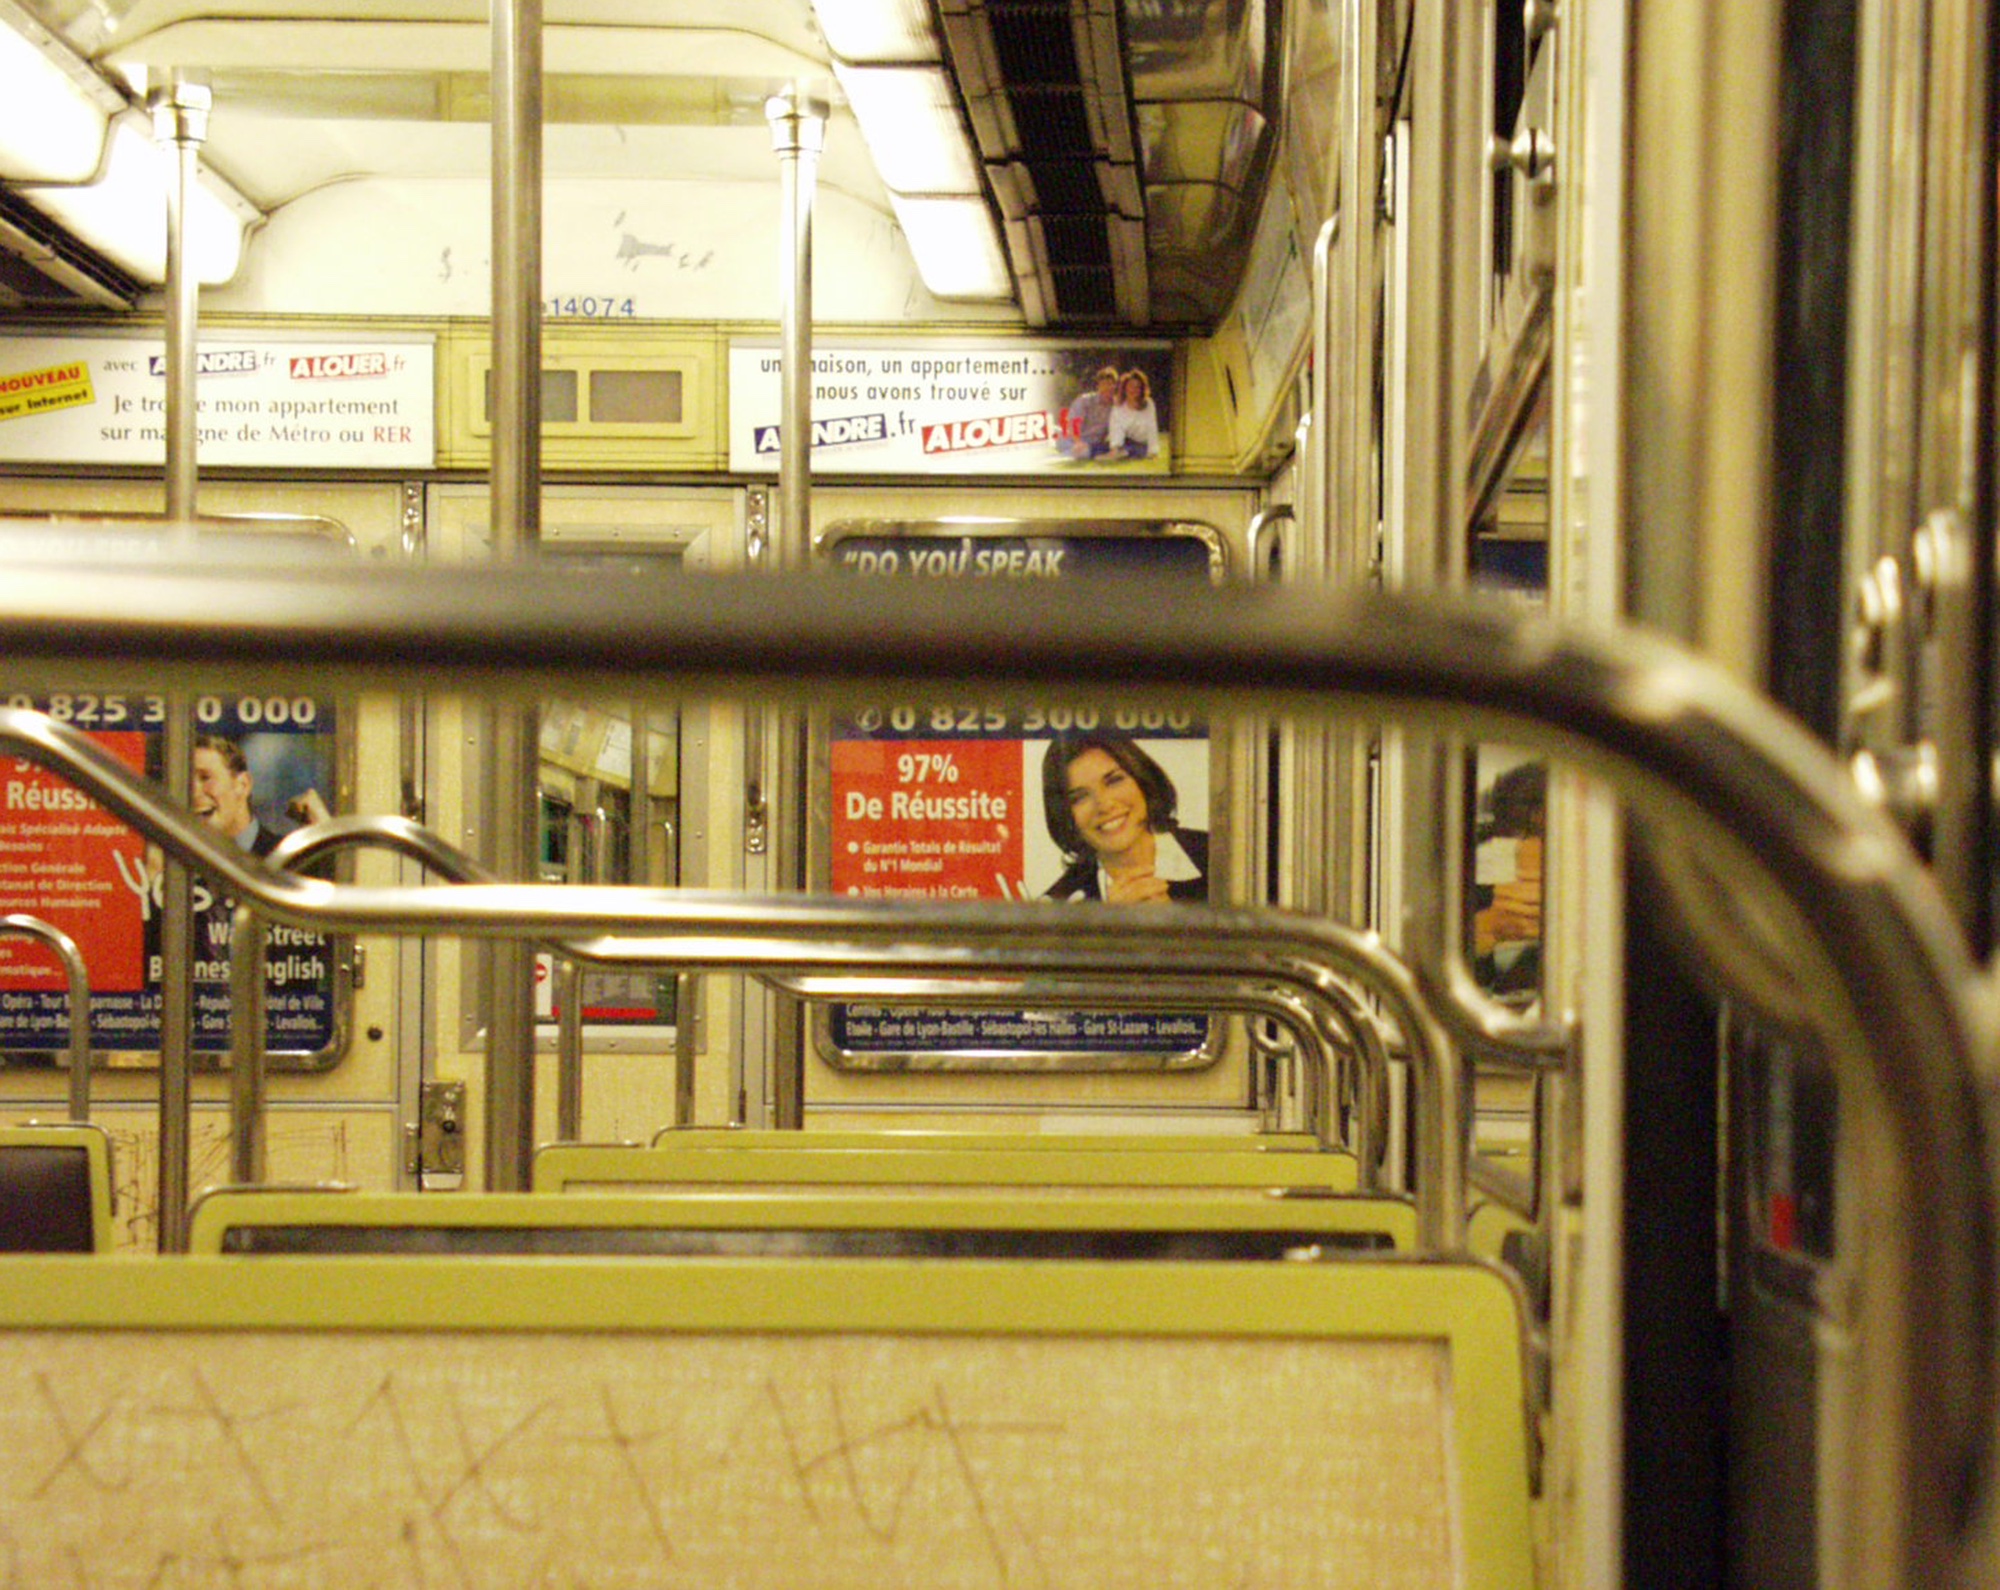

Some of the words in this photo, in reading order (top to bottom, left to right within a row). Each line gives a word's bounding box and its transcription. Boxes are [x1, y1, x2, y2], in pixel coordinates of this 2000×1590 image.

[551, 297, 635, 317] 14074
[103, 359, 138, 372] avec
[810, 353, 872, 377] aison,
[881, 359, 902, 374] un
[911, 356, 1055, 380] appartement...
[815, 385, 859, 400] nous
[867, 386, 921, 401] avons
[931, 380, 991, 401] trouvé
[1000, 386, 1028, 401] sur
[115, 394, 133, 415] Je
[141, 396, 206, 413] troe
[215, 400, 260, 413] mon
[268, 398, 398, 419] appartement
[101, 427, 132, 441] sur
[237, 424, 261, 442] de
[269, 424, 331, 443] Métro
[339, 428, 364, 443] ou
[373, 425, 412, 443] RER
[909, 550, 967, 577] YOU
[975, 549, 1064, 577] SPEAK
[50, 694, 127, 722] 825
[143, 696, 223, 724] 30
[237, 696, 317, 725] 000
[891, 705, 915, 731] 0
[930, 705, 1006, 731] 825
[1023, 707, 1099, 731] 300
[1114, 708, 1192, 731] 000
[897, 753, 960, 784] 97%
[7, 780, 98, 811] Réuss
[846, 791, 884, 820] De
[891, 790, 1007, 821] Réussite
[265, 954, 326, 986] nglish
